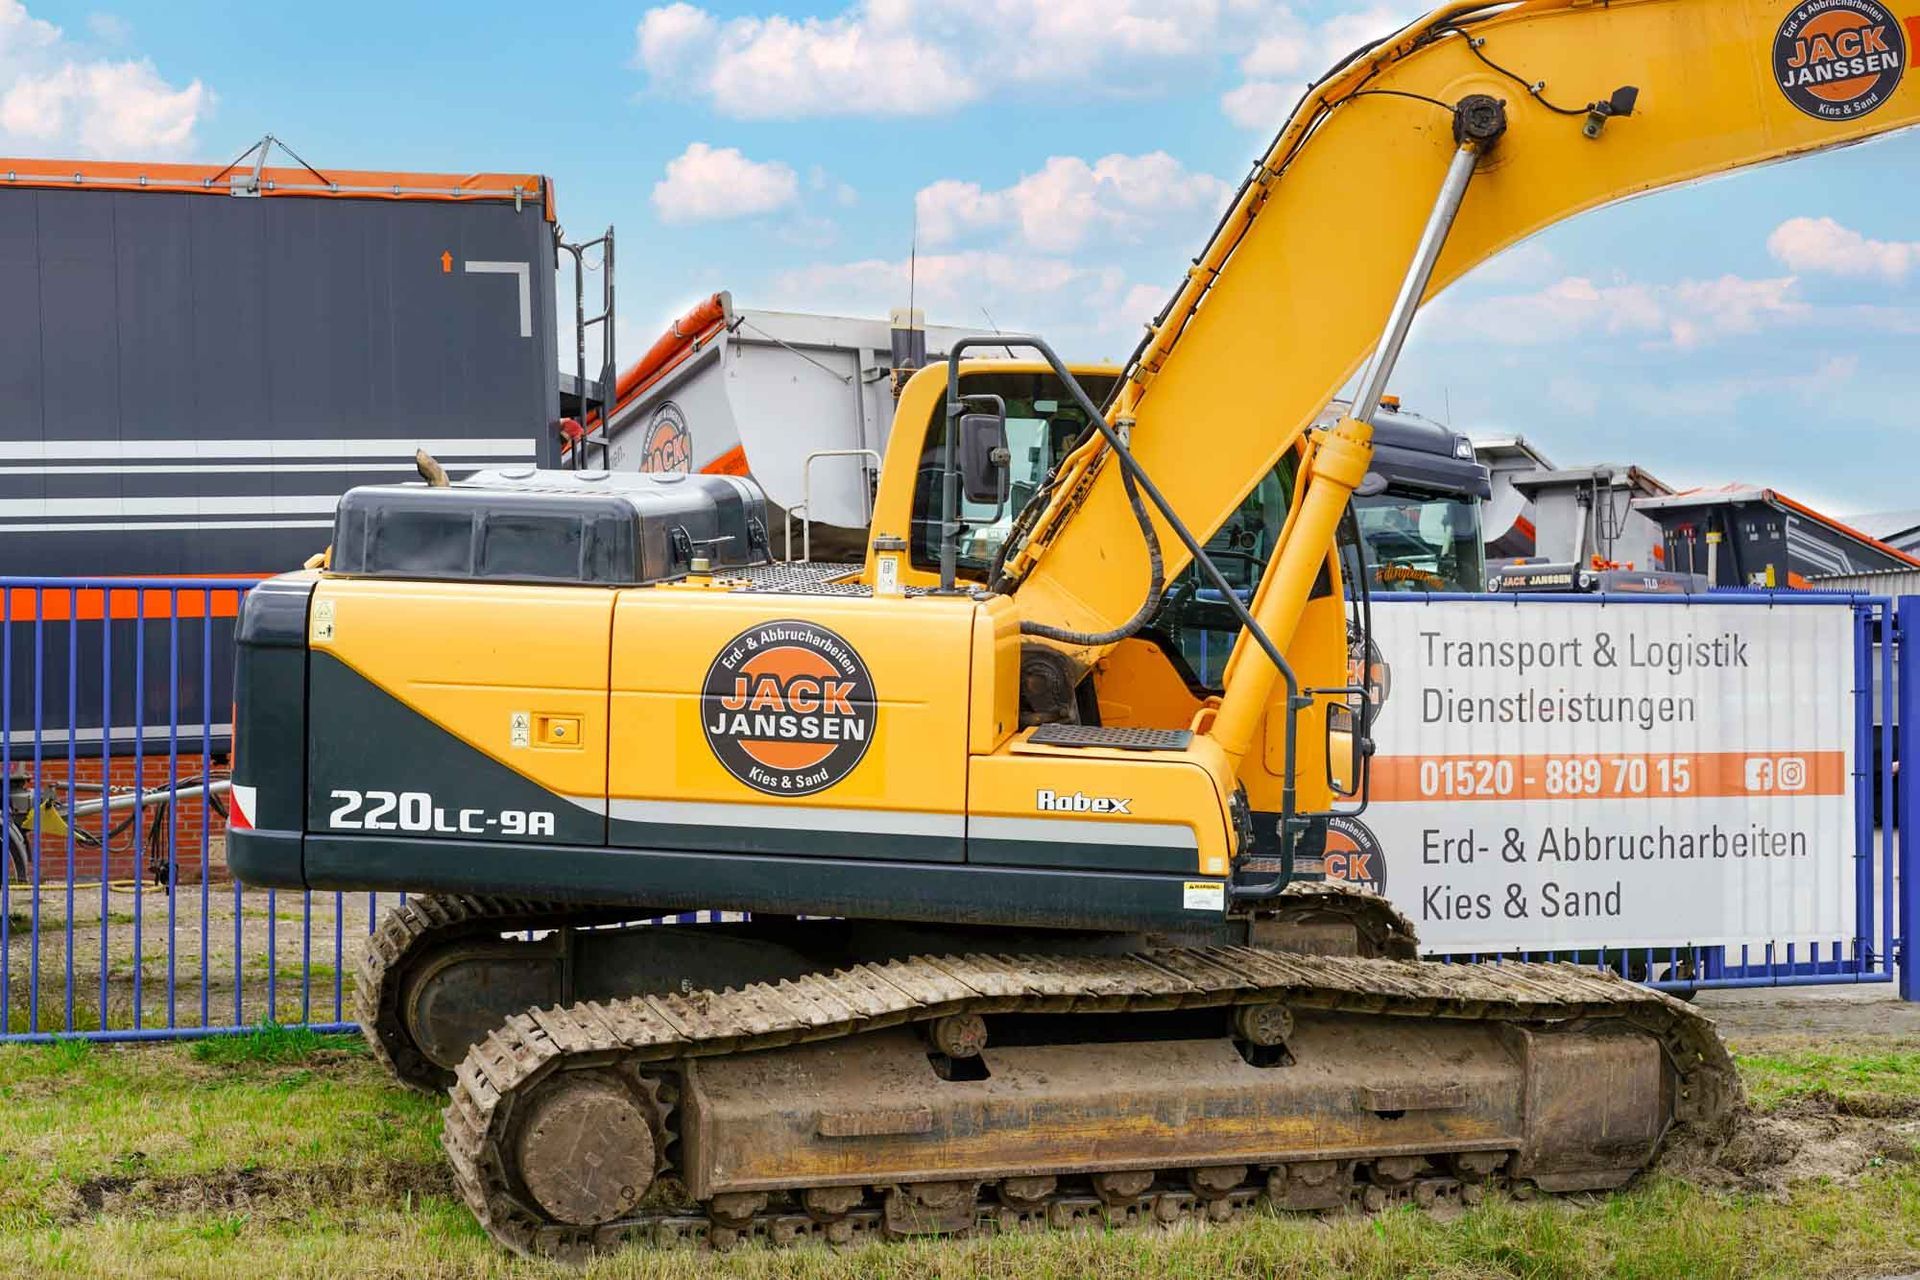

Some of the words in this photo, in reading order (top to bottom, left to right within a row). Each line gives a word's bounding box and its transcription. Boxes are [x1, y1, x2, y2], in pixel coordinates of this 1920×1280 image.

[1783, 20, 1799, 38] Erd-
[1798, 11, 1807, 21] &
[1788, 25, 1889, 68] JACK
[1783, 51, 1899, 87] JANSSEN
[1818, 103, 1841, 115] Kies
[1843, 104, 1852, 114] &
[1854, 93, 1879, 112] Sand
[1503, 576, 1526, 586] JACK
[722, 647, 745, 670] Erd-
[746, 637, 758, 651] &
[760, 628, 856, 675] Abbrucharbeiten
[1420, 632, 1583, 676] Transport
[1593, 632, 1618, 667] &
[1629, 632, 1749, 675] Logistik
[721, 677, 857, 715] JACK
[1423, 688, 1694, 731] Dienstleistungen
[710, 713, 865, 741] JANSSEN
[749, 766, 777, 787] Kies
[781, 775, 792, 788] &
[796, 768, 829, 788] Sand
[1420, 760, 1514, 796] 01520
[1546, 759, 1601, 795] 889
[1610, 758, 1648, 793] 70
[1657, 758, 1691, 793] 15
[1422, 828, 1489, 865] Erd-
[1501, 827, 1527, 863] &
[1537, 823, 1806, 862] Abbrucharbeiten
[1422, 885, 1491, 920] Kies
[1503, 883, 1528, 918] &
[1540, 881, 1622, 917] Sand
